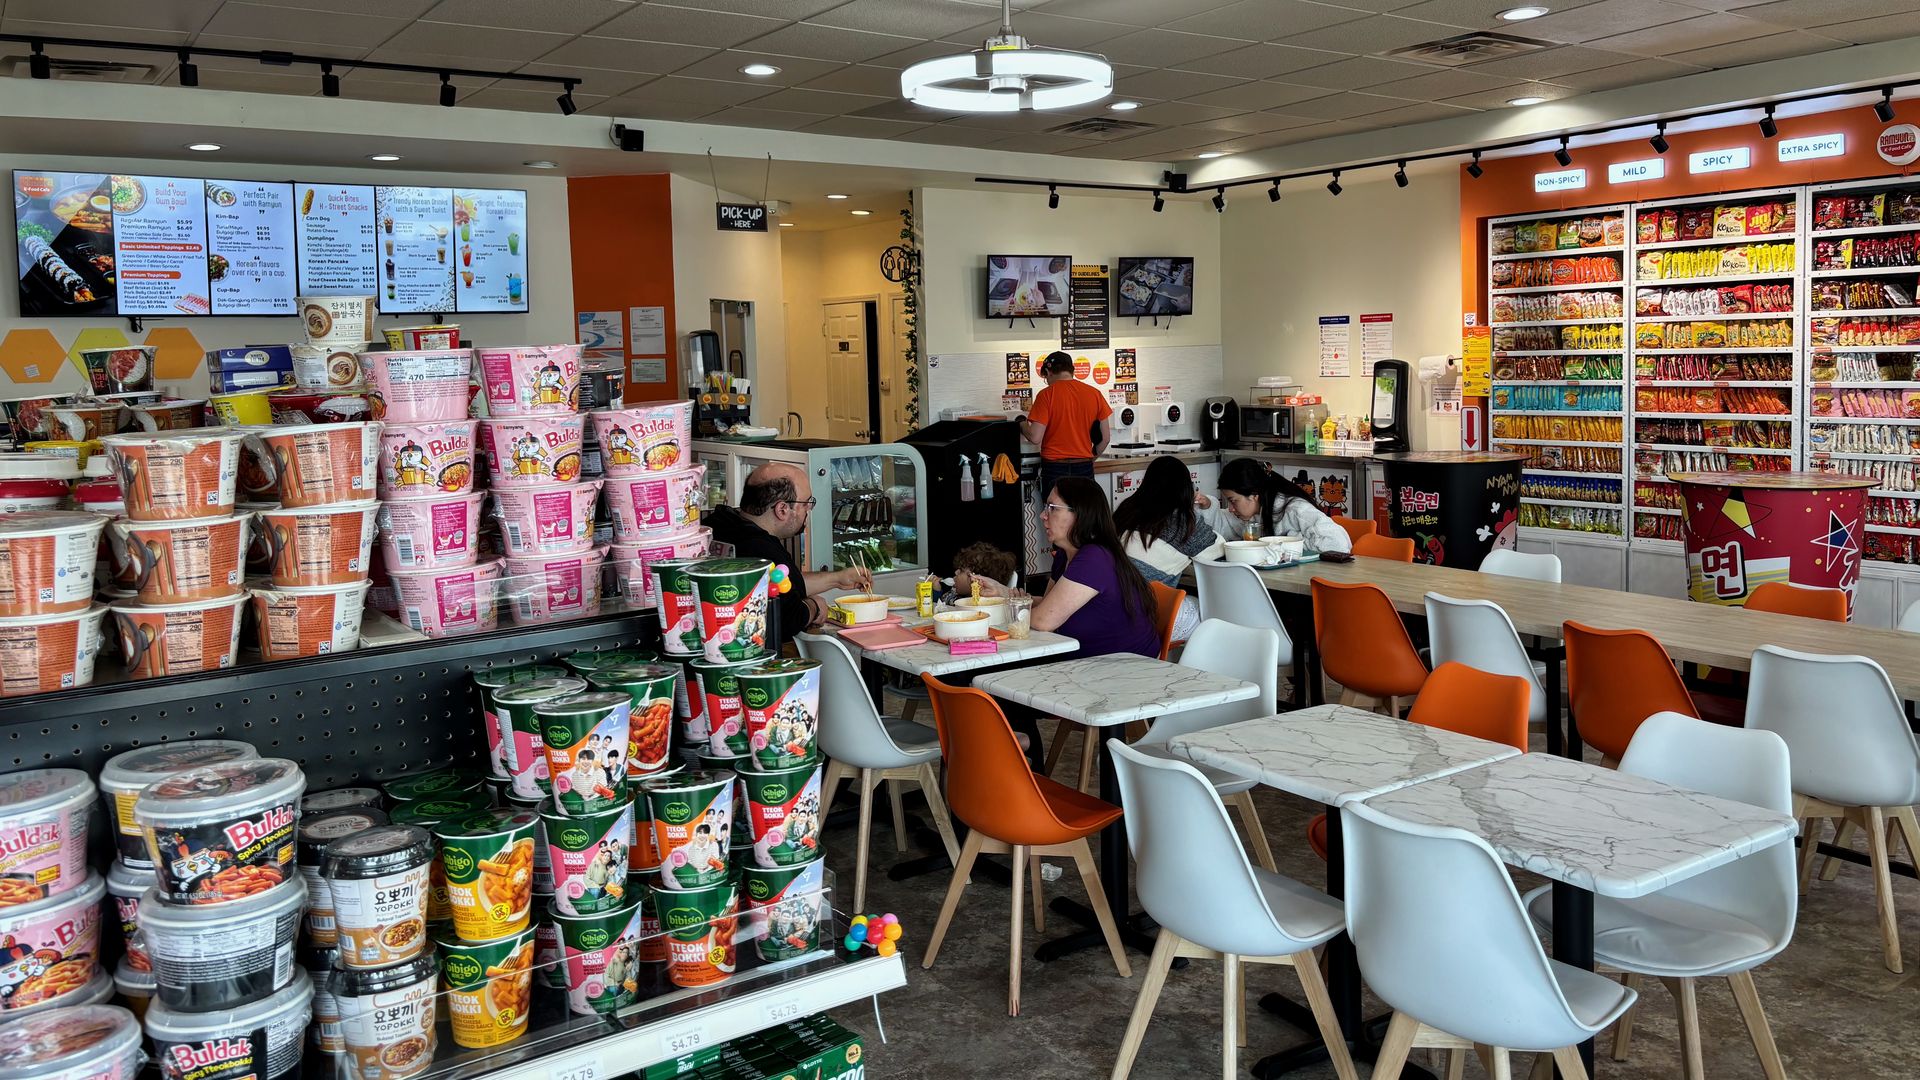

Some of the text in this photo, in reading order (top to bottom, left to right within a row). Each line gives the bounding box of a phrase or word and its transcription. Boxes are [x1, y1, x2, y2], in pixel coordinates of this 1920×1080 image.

[1880, 132, 1909, 146] RAMYUN
[1781, 139, 1840, 155] EXTRA SPICY
[1702, 154, 1734, 167] SPICY
[1622, 165, 1648, 177] MILD
[1536, 175, 1582, 188] NON-SPICY
[155, 188, 187, 197] Build Your
[243, 191, 279, 199] Perfect Pair
[327, 194, 360, 203] Quick Bites
[258, 201, 282, 209] Ramyun
[328, 203, 368, 211] Street Snacks
[721, 206, 763, 220] PICK-UP
[734, 220, 752, 229] HERE
[258, 260, 280, 268] flavors
[246, 269, 260, 277] rice,
[525, 352, 548, 360] Samyang
[408, 373, 424, 381] 470
[630, 419, 675, 440] Buldak
[427, 435, 470, 458] Buldak
[1809, 461, 1836, 471] tangle
[1486, 473, 1513, 490] NYAM
[1701, 540, 1747, 600] 면
[715, 588, 738, 598] bibigo
[189, 624, 202, 632] 290
[22, 641, 37, 649] 290
[548, 729, 570, 741] bibigo
[763, 789, 787, 799] bibigo
[666, 806, 690, 818] bibigo
[762, 806, 784, 814] TTEOK
[763, 812, 785, 820] BOKKI
[223, 805, 294, 852] Buldak
[563, 833, 588, 843] bibigo
[237, 843, 261, 860] Spicy
[562, 852, 585, 860] TTEOK
[563, 858, 586, 866] BOKKI
[374, 884, 413, 905] 요뽀끼
[374, 898, 414, 913] YOPOKKI
[668, 912, 703, 928] bibigo
[582, 933, 607, 943] bibigo
[669, 942, 705, 952] TTEOK
[582, 958, 605, 966] BOKKI
[671, 952, 706, 962] BOKKI
[446, 962, 480, 979] bibigo
[374, 1002, 414, 1025] 요뽀끼
[770, 1003, 798, 1021] $4.79
[268, 1019, 286, 1030] Facts
[374, 1016, 415, 1032] YOPOKKI
[671, 1033, 700, 1052] $4.79
[170, 1037, 252, 1073] Buldak
[203, 1056, 254, 1076] Tteokbokki
[807, 1058, 823, 1068] LOTTE
